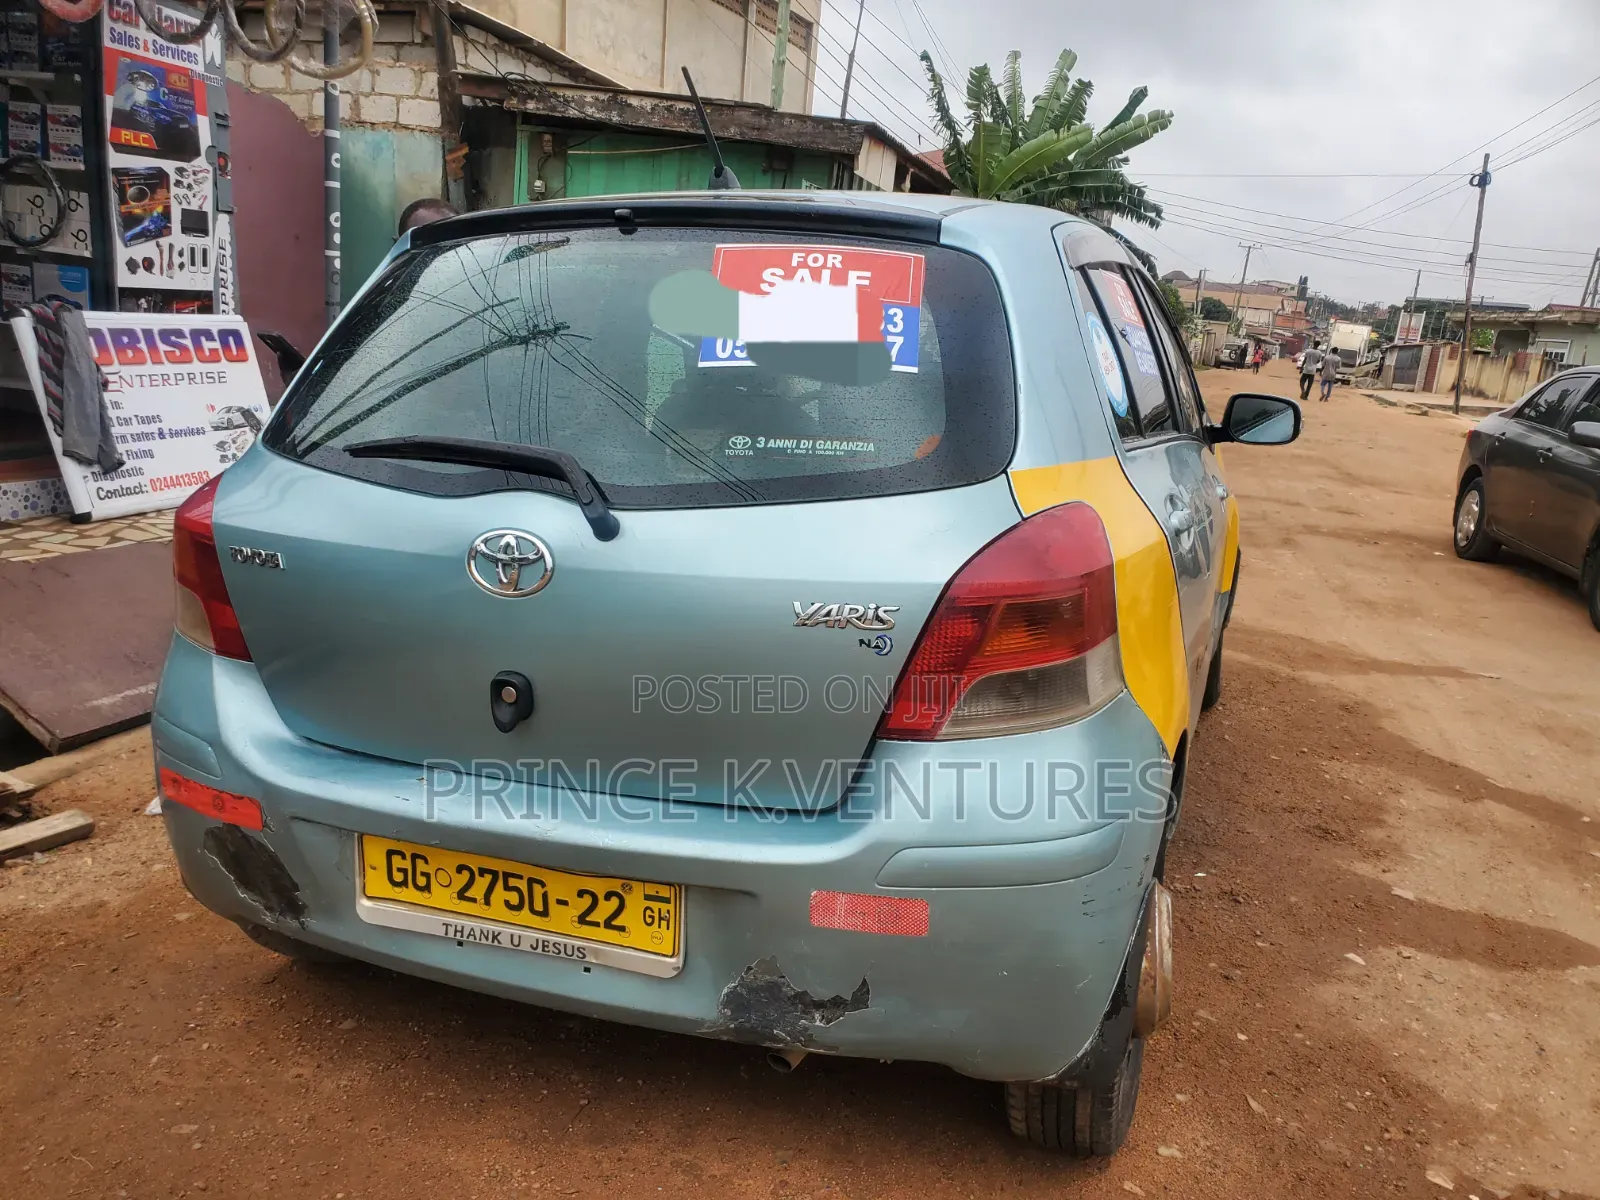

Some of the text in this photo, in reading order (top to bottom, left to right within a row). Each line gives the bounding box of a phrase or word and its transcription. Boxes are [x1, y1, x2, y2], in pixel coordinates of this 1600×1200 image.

[109, 26, 199, 66] Sales & Services
[121, 130, 149, 147] PLC
[791, 252, 843, 269] FOR
[103, 370, 228, 394] ENTERPRISE
[116, 416, 134, 428] Car
[134, 414, 163, 426] Tapes
[157, 427, 166, 441] &
[168, 426, 206, 439] Services
[756, 436, 875, 452] 3 ANNI DI GARANZIA
[125, 448, 155, 461] Fixing
[90, 465, 145, 483] Diagnostic
[96, 482, 149, 501] Contact:
[228, 545, 287, 571] TOYOTA
[791, 601, 900, 631] YARIS
[385, 848, 628, 933] GG 2750-22
[642, 905, 671, 931] GH
[441, 922, 588, 961] THANK U JESUS
